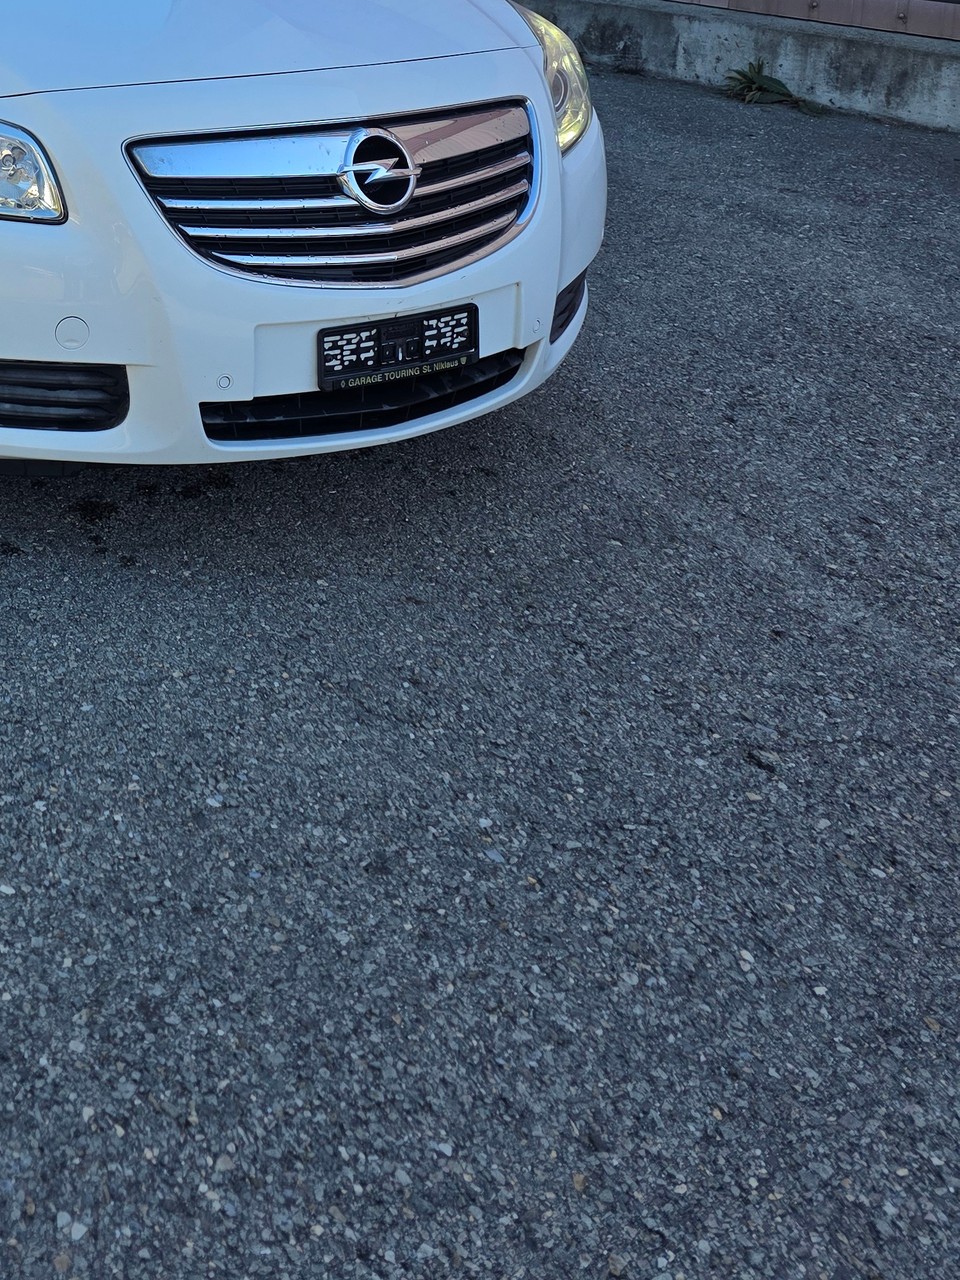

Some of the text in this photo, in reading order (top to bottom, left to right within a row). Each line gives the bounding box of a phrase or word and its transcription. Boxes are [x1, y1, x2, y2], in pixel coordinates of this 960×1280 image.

[348, 374, 382, 387] GARAGE
[384, 366, 420, 381] TOURING
[433, 359, 459, 371] Niklaus
